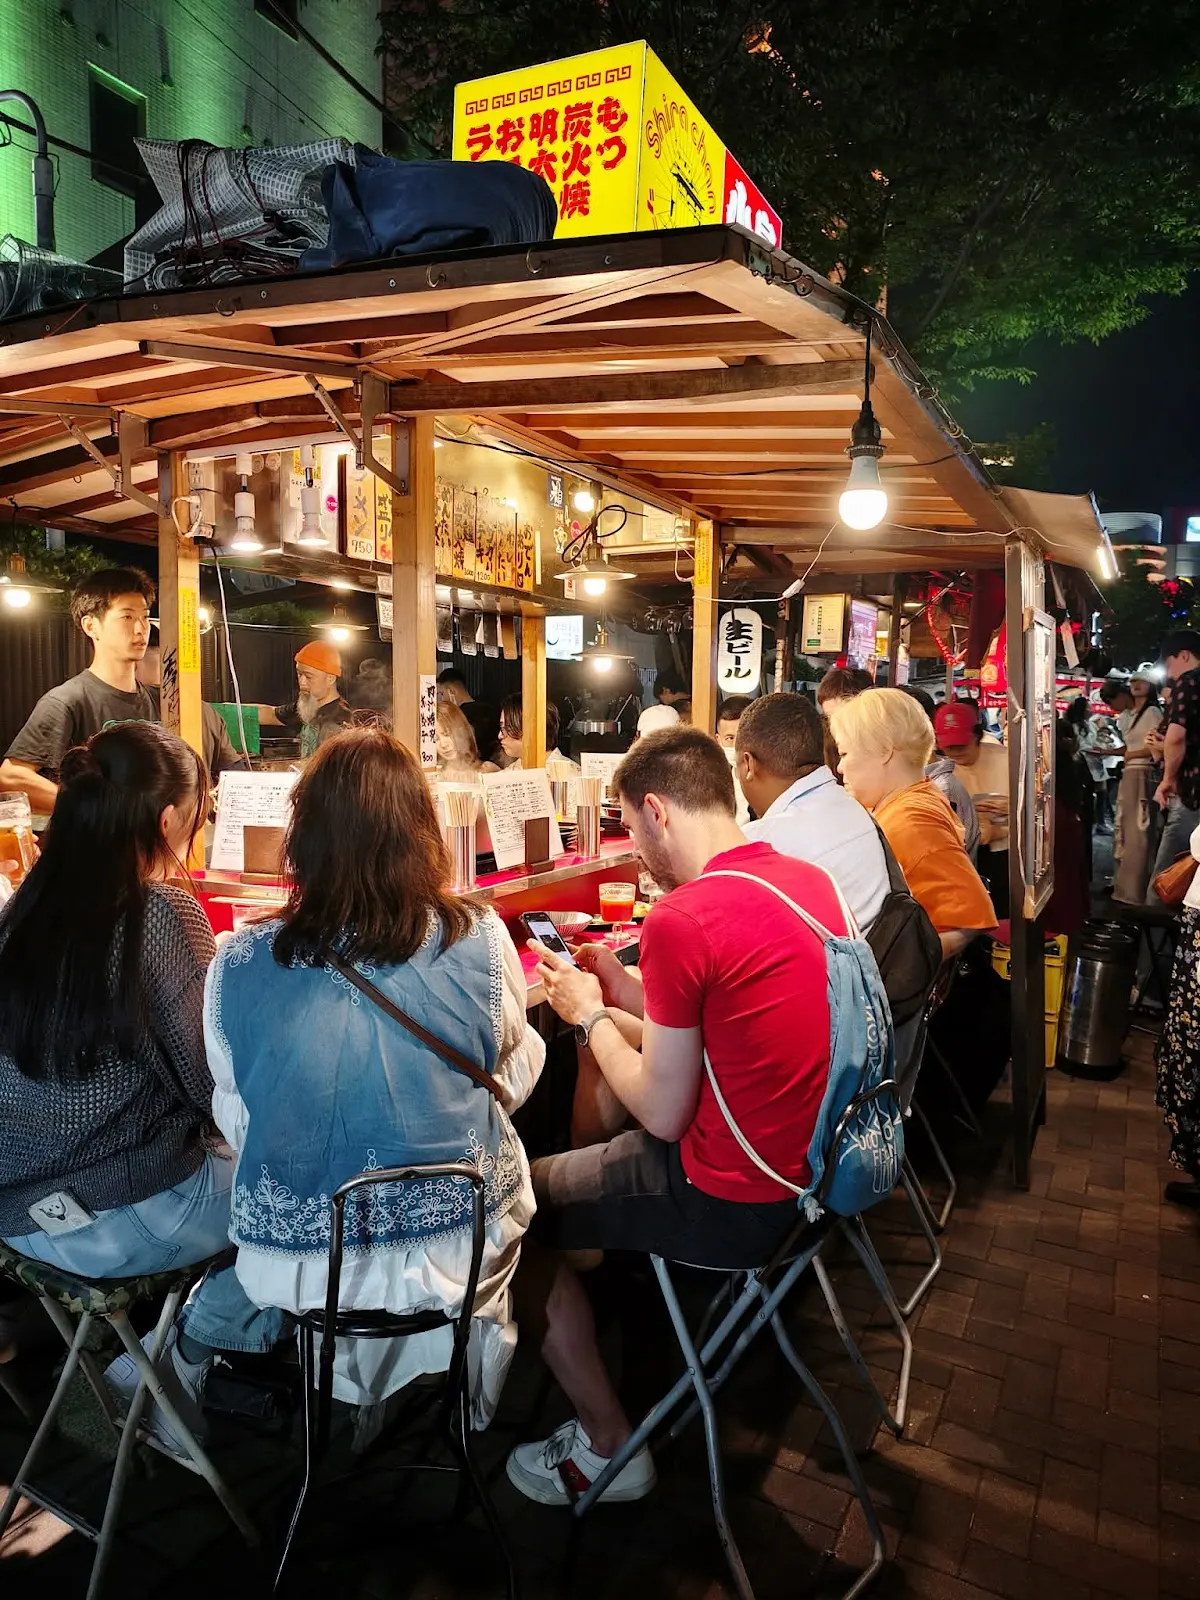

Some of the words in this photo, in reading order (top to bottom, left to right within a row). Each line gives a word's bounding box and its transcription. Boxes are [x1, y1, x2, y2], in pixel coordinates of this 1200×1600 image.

[597, 96, 628, 171] もつ
[646, 94, 688, 159] Shira
[560, 101, 593, 220] 炭火焼
[351, 539, 373, 554] 750
[723, 620, 754, 679] 生ビール
